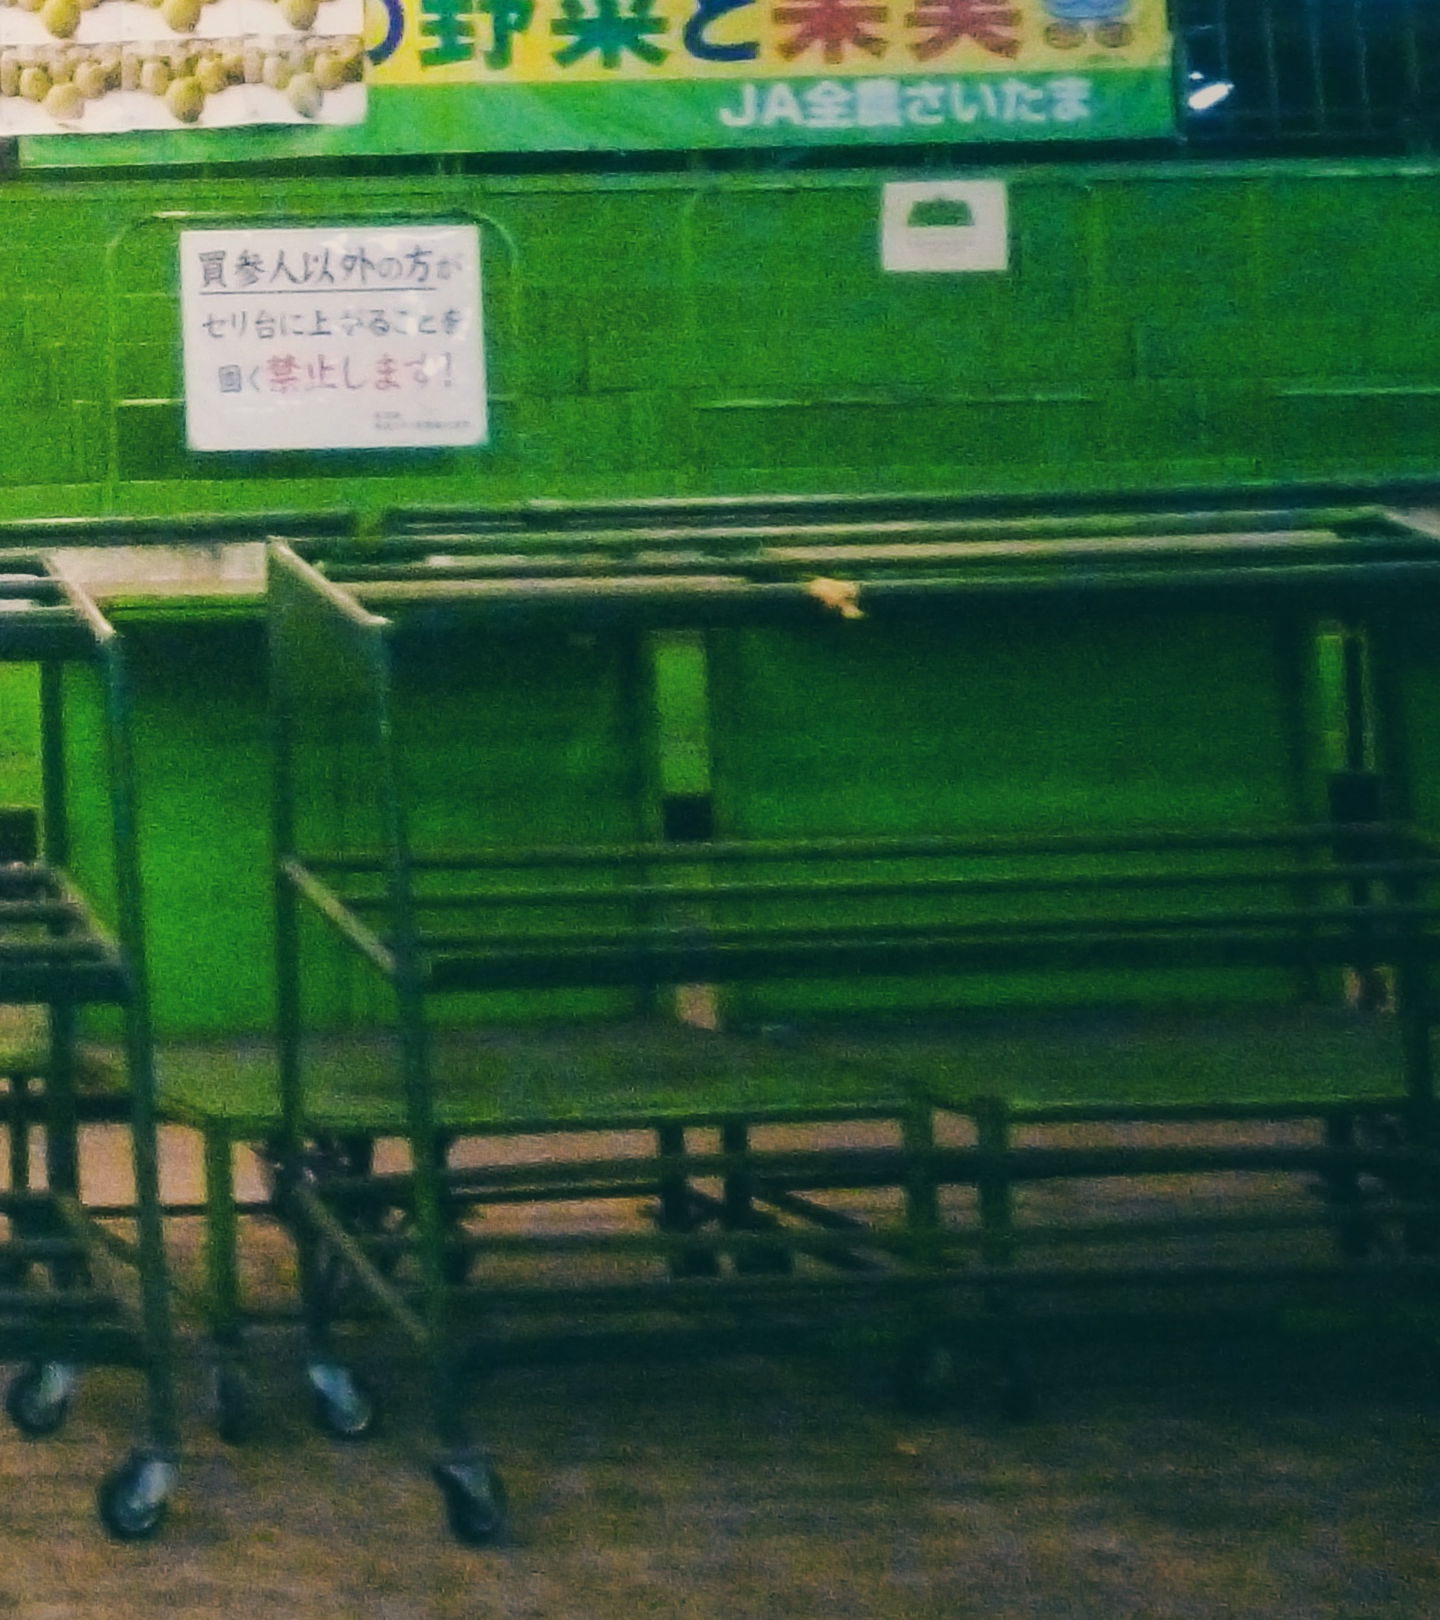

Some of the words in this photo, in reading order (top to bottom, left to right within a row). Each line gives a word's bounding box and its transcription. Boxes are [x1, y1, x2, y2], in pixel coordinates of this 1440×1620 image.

[198, 246, 464, 288] 買参人以外の方が
